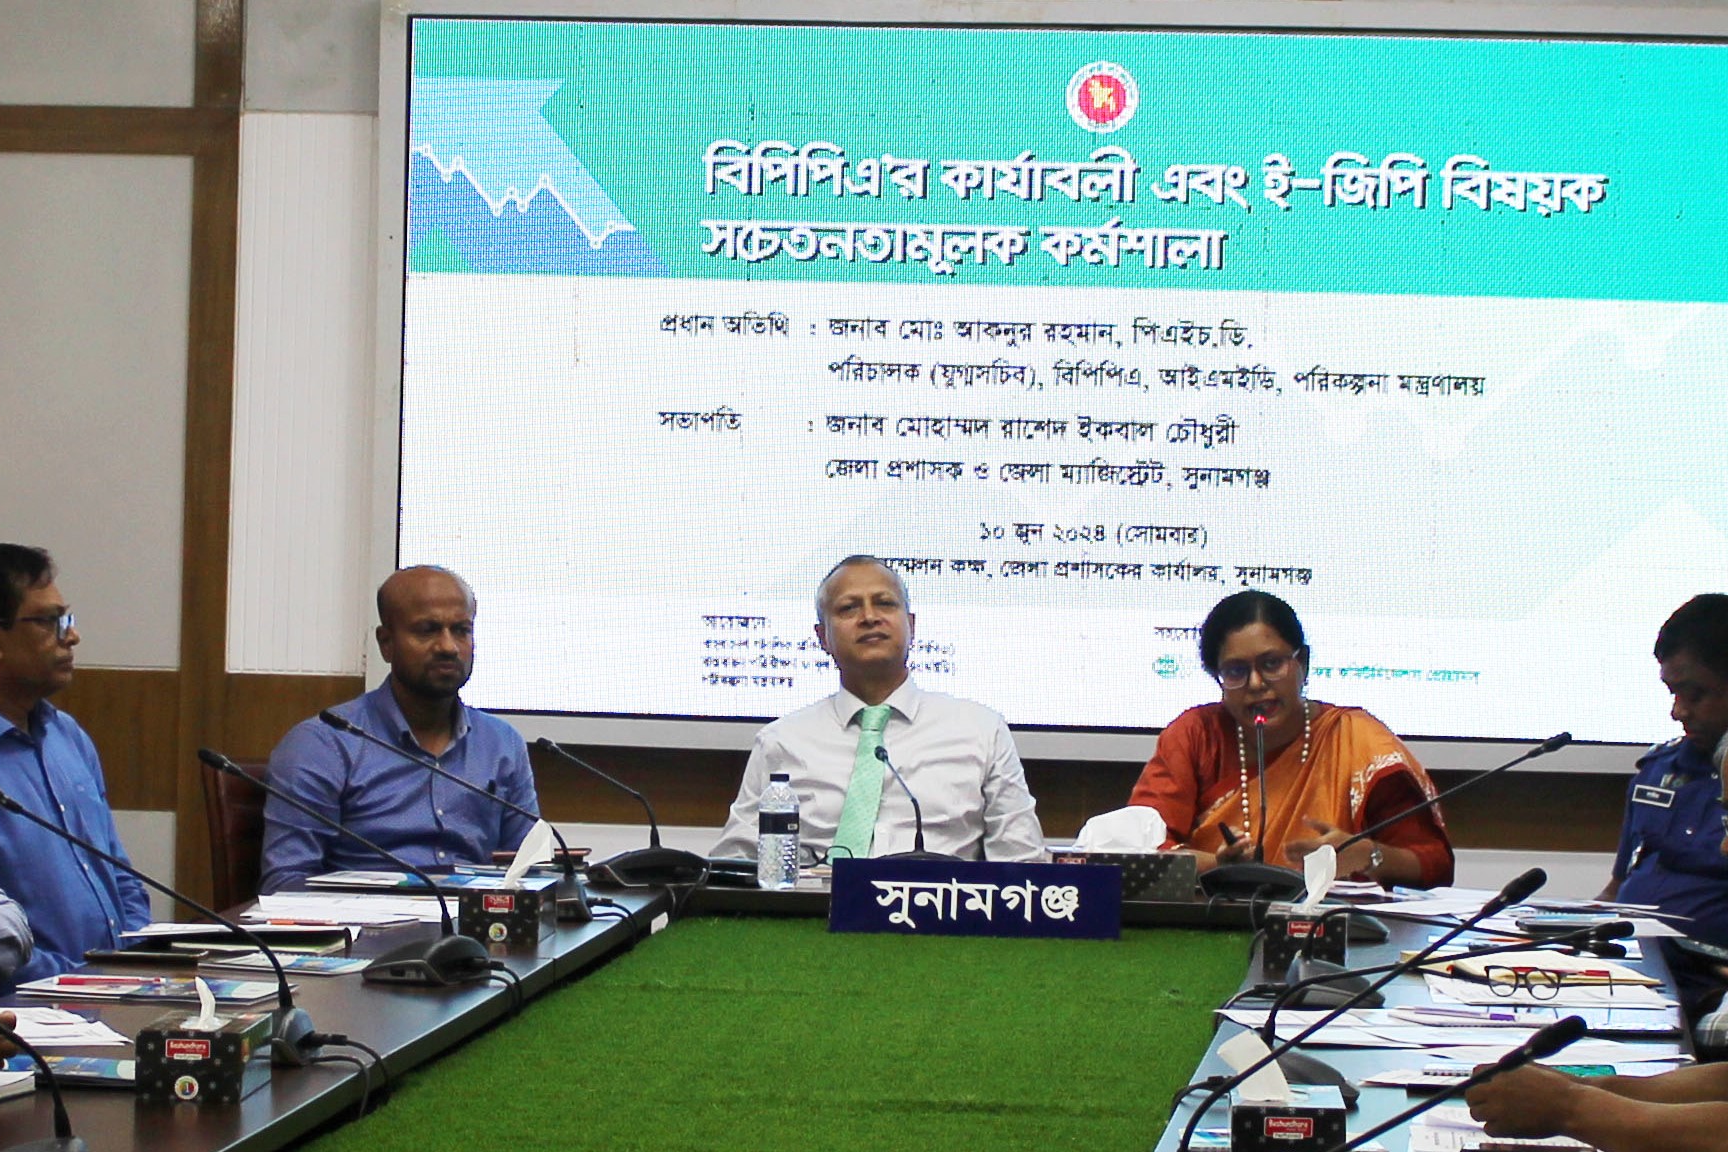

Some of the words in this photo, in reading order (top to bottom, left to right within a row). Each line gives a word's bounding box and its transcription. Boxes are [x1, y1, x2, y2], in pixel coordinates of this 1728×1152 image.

[940, 145, 1140, 203] কার্যাবলী
[1152, 162, 1252, 214] এবং
[1440, 154, 1609, 217] বিষয়ক
[701, 218, 1032, 277] সচেতনতামূলক
[1040, 216, 1229, 270] কর্মশালা
[871, 878, 1079, 928] সুনামগঞ্জ
